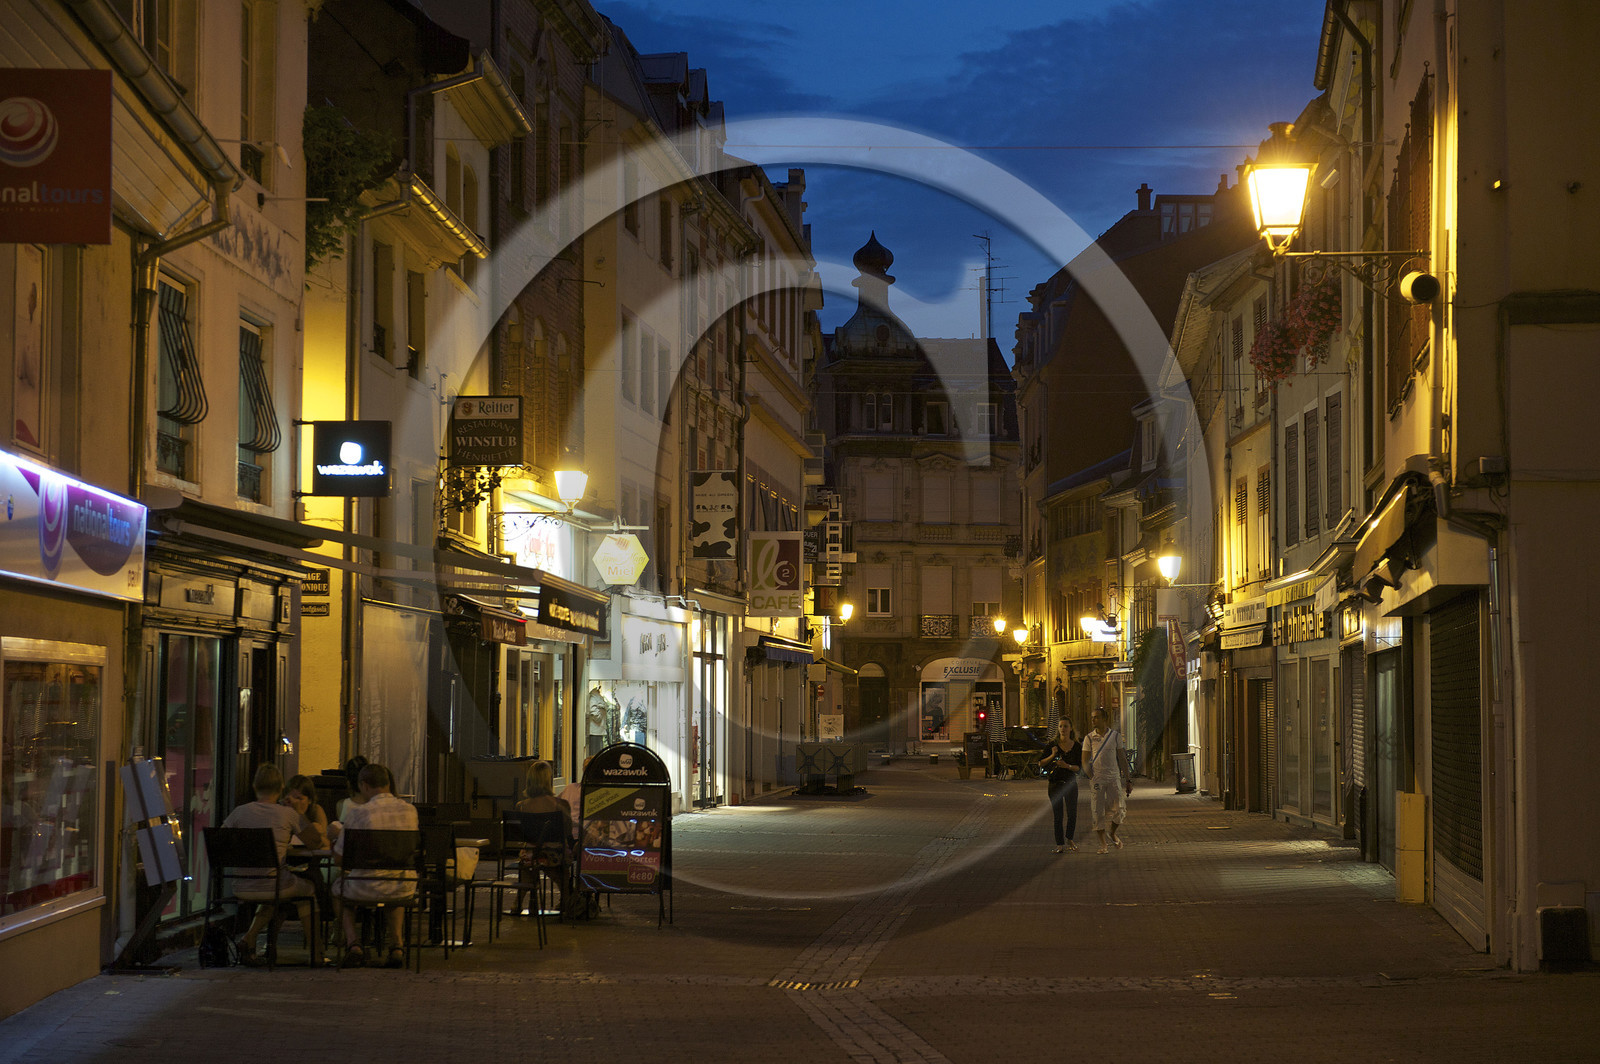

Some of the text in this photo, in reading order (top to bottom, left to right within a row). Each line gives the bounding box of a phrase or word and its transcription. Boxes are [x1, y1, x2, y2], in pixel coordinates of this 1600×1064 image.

[0, 180, 104, 204] naltours
[479, 400, 514, 416] Reitter
[456, 420, 516, 435] RESTAURANT
[455, 436, 517, 447] WINSTUB
[456, 447, 513, 462] HENRIETTE
[303, 572, 321, 581] AGE
[607, 566, 634, 576] Miel
[301, 583, 328, 592] ONIQUE
[752, 593, 799, 610] CAFÉ
[1169, 621, 1186, 677] TABAC
[943, 666, 981, 678] EXCLUSIF
[603, 766, 648, 777] wazawok
[620, 808, 658, 817] wazawok
[584, 854, 605, 863] Wok
[616, 856, 658, 865] emporter
